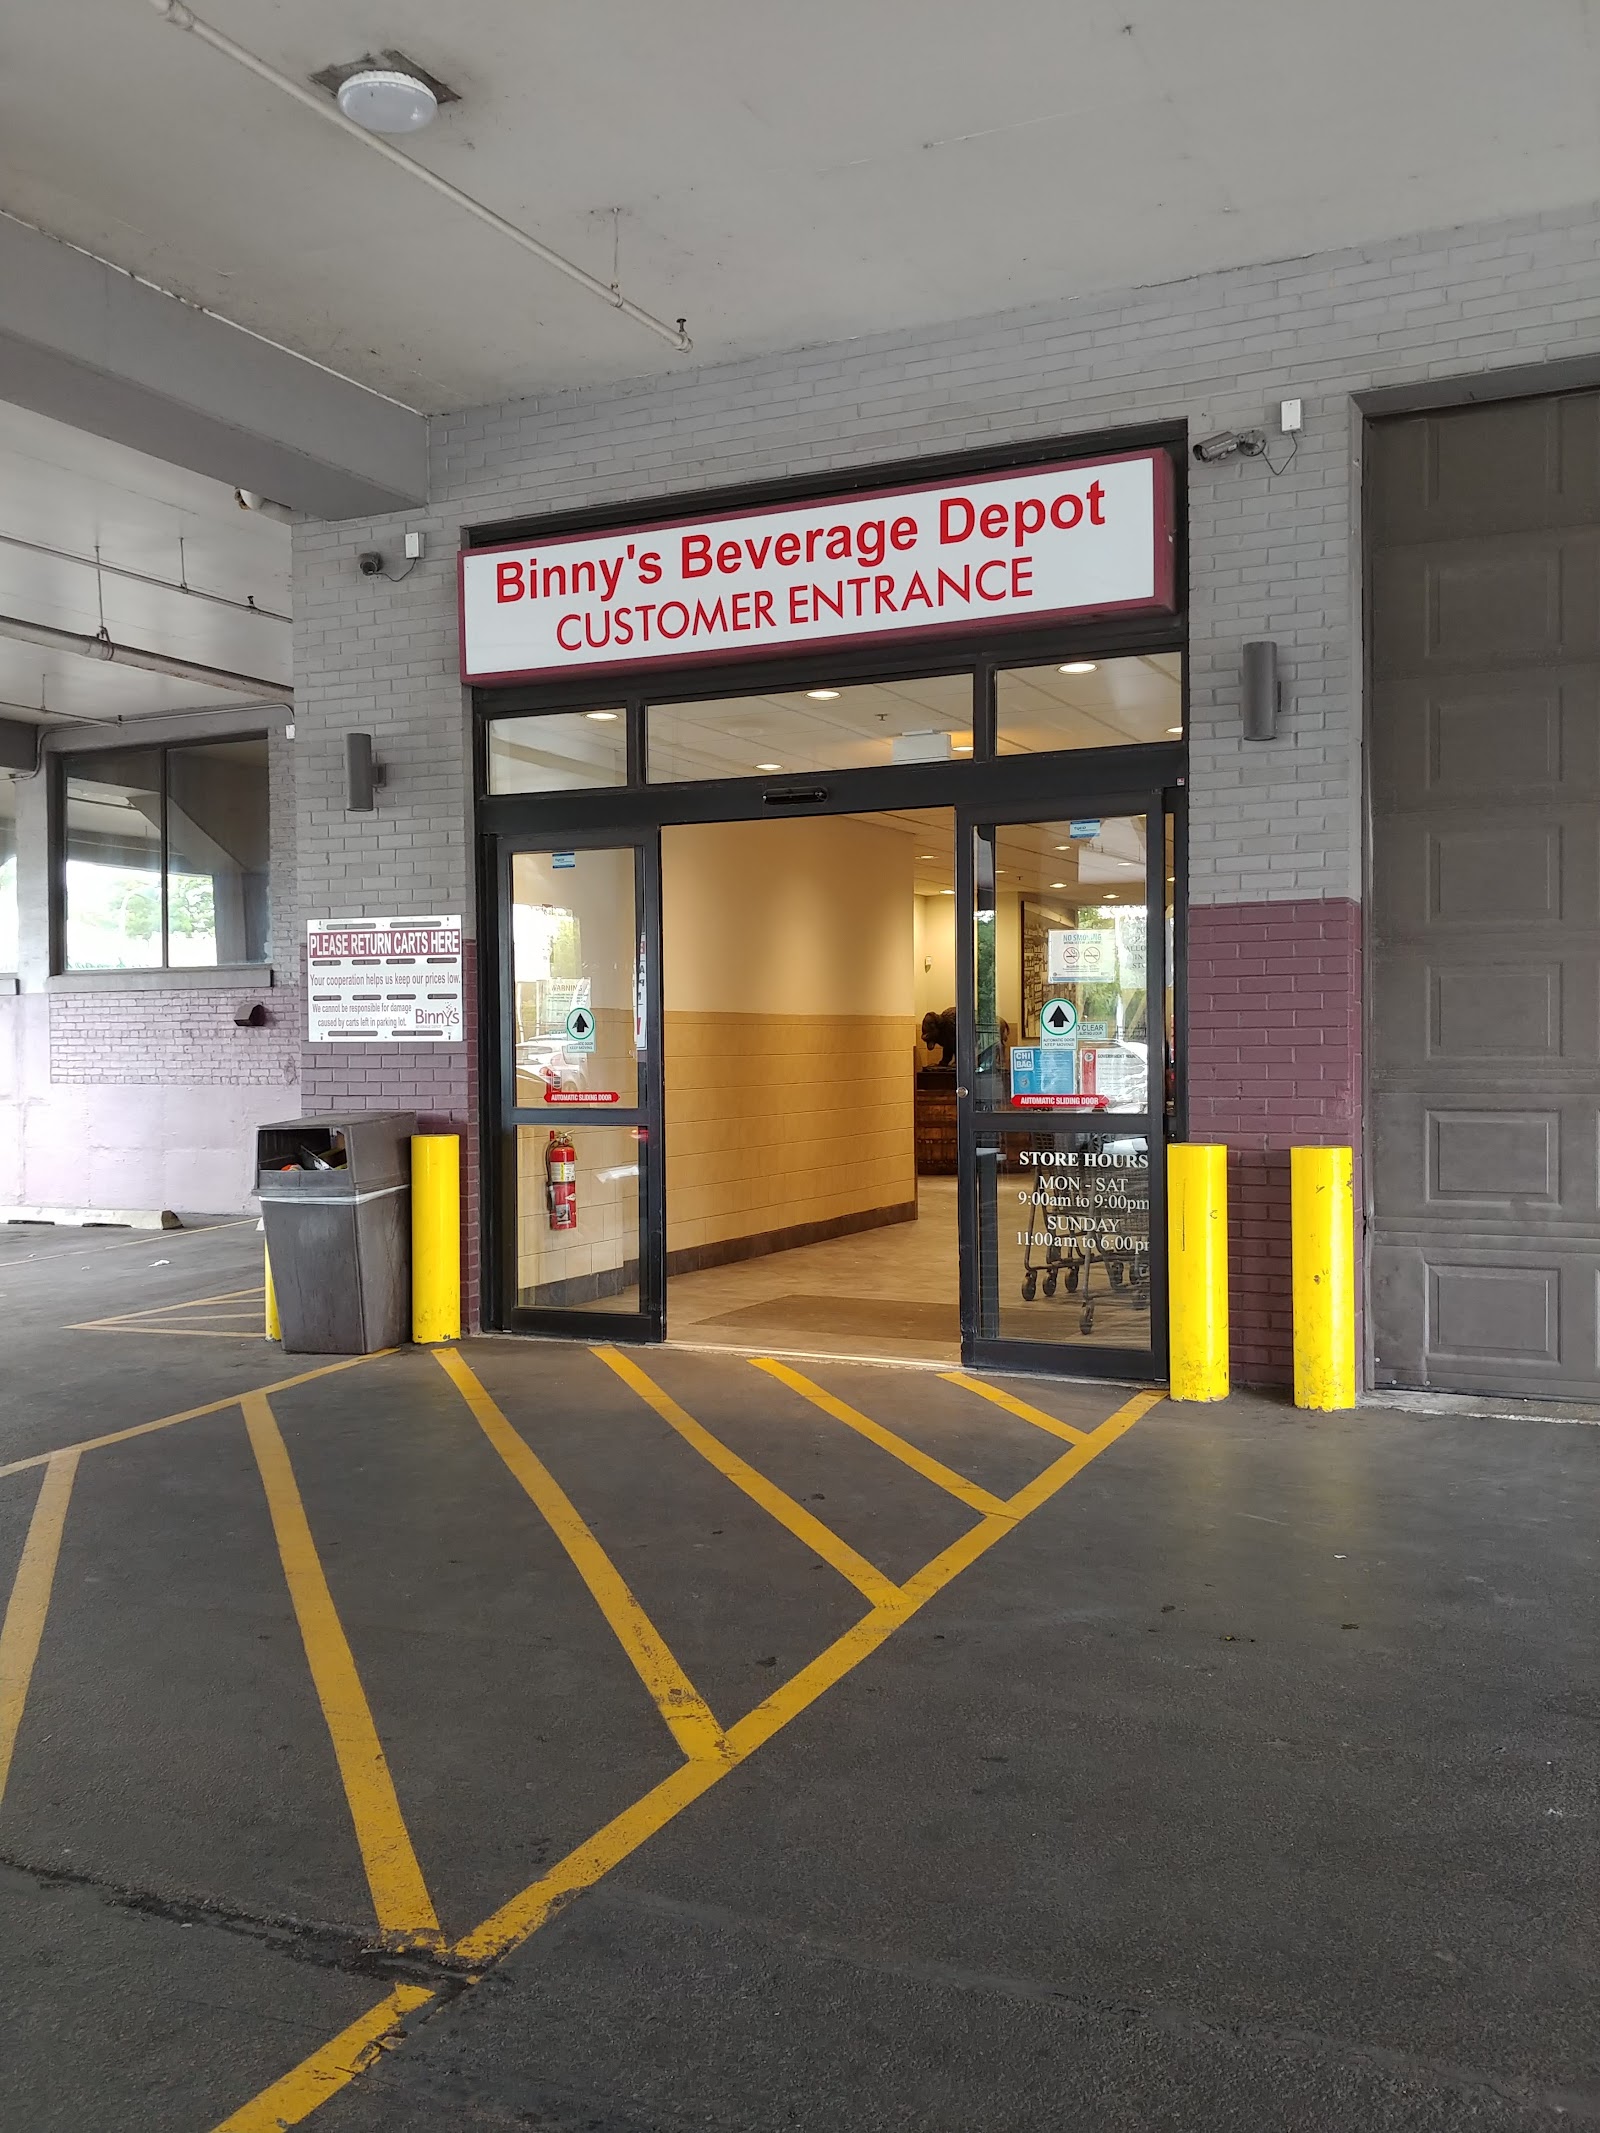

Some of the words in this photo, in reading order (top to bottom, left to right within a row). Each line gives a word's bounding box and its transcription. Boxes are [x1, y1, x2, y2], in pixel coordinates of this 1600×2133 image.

[496, 544, 662, 604] Binny's
[681, 514, 918, 580] Beverage
[939, 479, 1106, 549] Depot
[556, 590, 777, 651] CUSTOMER
[790, 556, 1034, 623] ENTRANCE
[310, 934, 349, 956] PLEASE
[351, 932, 392, 955] RETURN
[394, 931, 428, 954] CARTS
[430, 930, 460, 953] HERE
[310, 974, 325, 986] Your
[326, 974, 365, 988] cooperation
[366, 973, 383, 987] helps
[385, 976, 393, 985] us
[395, 973, 410, 986] keep
[412, 975, 424, 985] our
[425, 973, 445, 987] prices
[447, 972, 460, 984] low.
[312, 1003, 321, 1013] We
[321, 1004, 340, 1013] cannot
[341, 1003, 348, 1012] be
[349, 1003, 380, 1014] responsible
[381, 1003, 389, 1012] for
[390, 1003, 412, 1014] damage
[318, 1018, 337, 1027] caused
[338, 1018, 345, 1029] by
[346, 1018, 359, 1027] carts
[360, 1017, 369, 1026] left
[370, 1017, 376, 1026] in
[377, 1017, 396, 1028] parking
[397, 1016, 406, 1026] lot.
[1015, 1052, 1031, 1060] CHI
[1016, 1060, 1032, 1068] BAG
[551, 1093, 578, 1101] AUTOMATIC
[578, 1093, 597, 1101] SLIDING
[598, 1093, 612, 1101] DOOR
[1020, 1096, 1055, 1105] AUTOMATIC
[1056, 1096, 1080, 1105] SLIDING
[1081, 1096, 1099, 1105] DOOR
[1019, 1151, 1078, 1167] STORE
[1084, 1152, 1149, 1168] HOURS
[1038, 1175, 1081, 1190] MON
[1095, 1177, 1128, 1192] SAT
[1018, 1191, 1071, 1207] 9:00am
[1075, 1193, 1089, 1208] to
[1094, 1194, 1150, 1213] 9:00pm
[1047, 1215, 1121, 1233] SUNDAY
[1016, 1231, 1077, 1248] 11:00am
[1082, 1235, 1096, 1249] to
